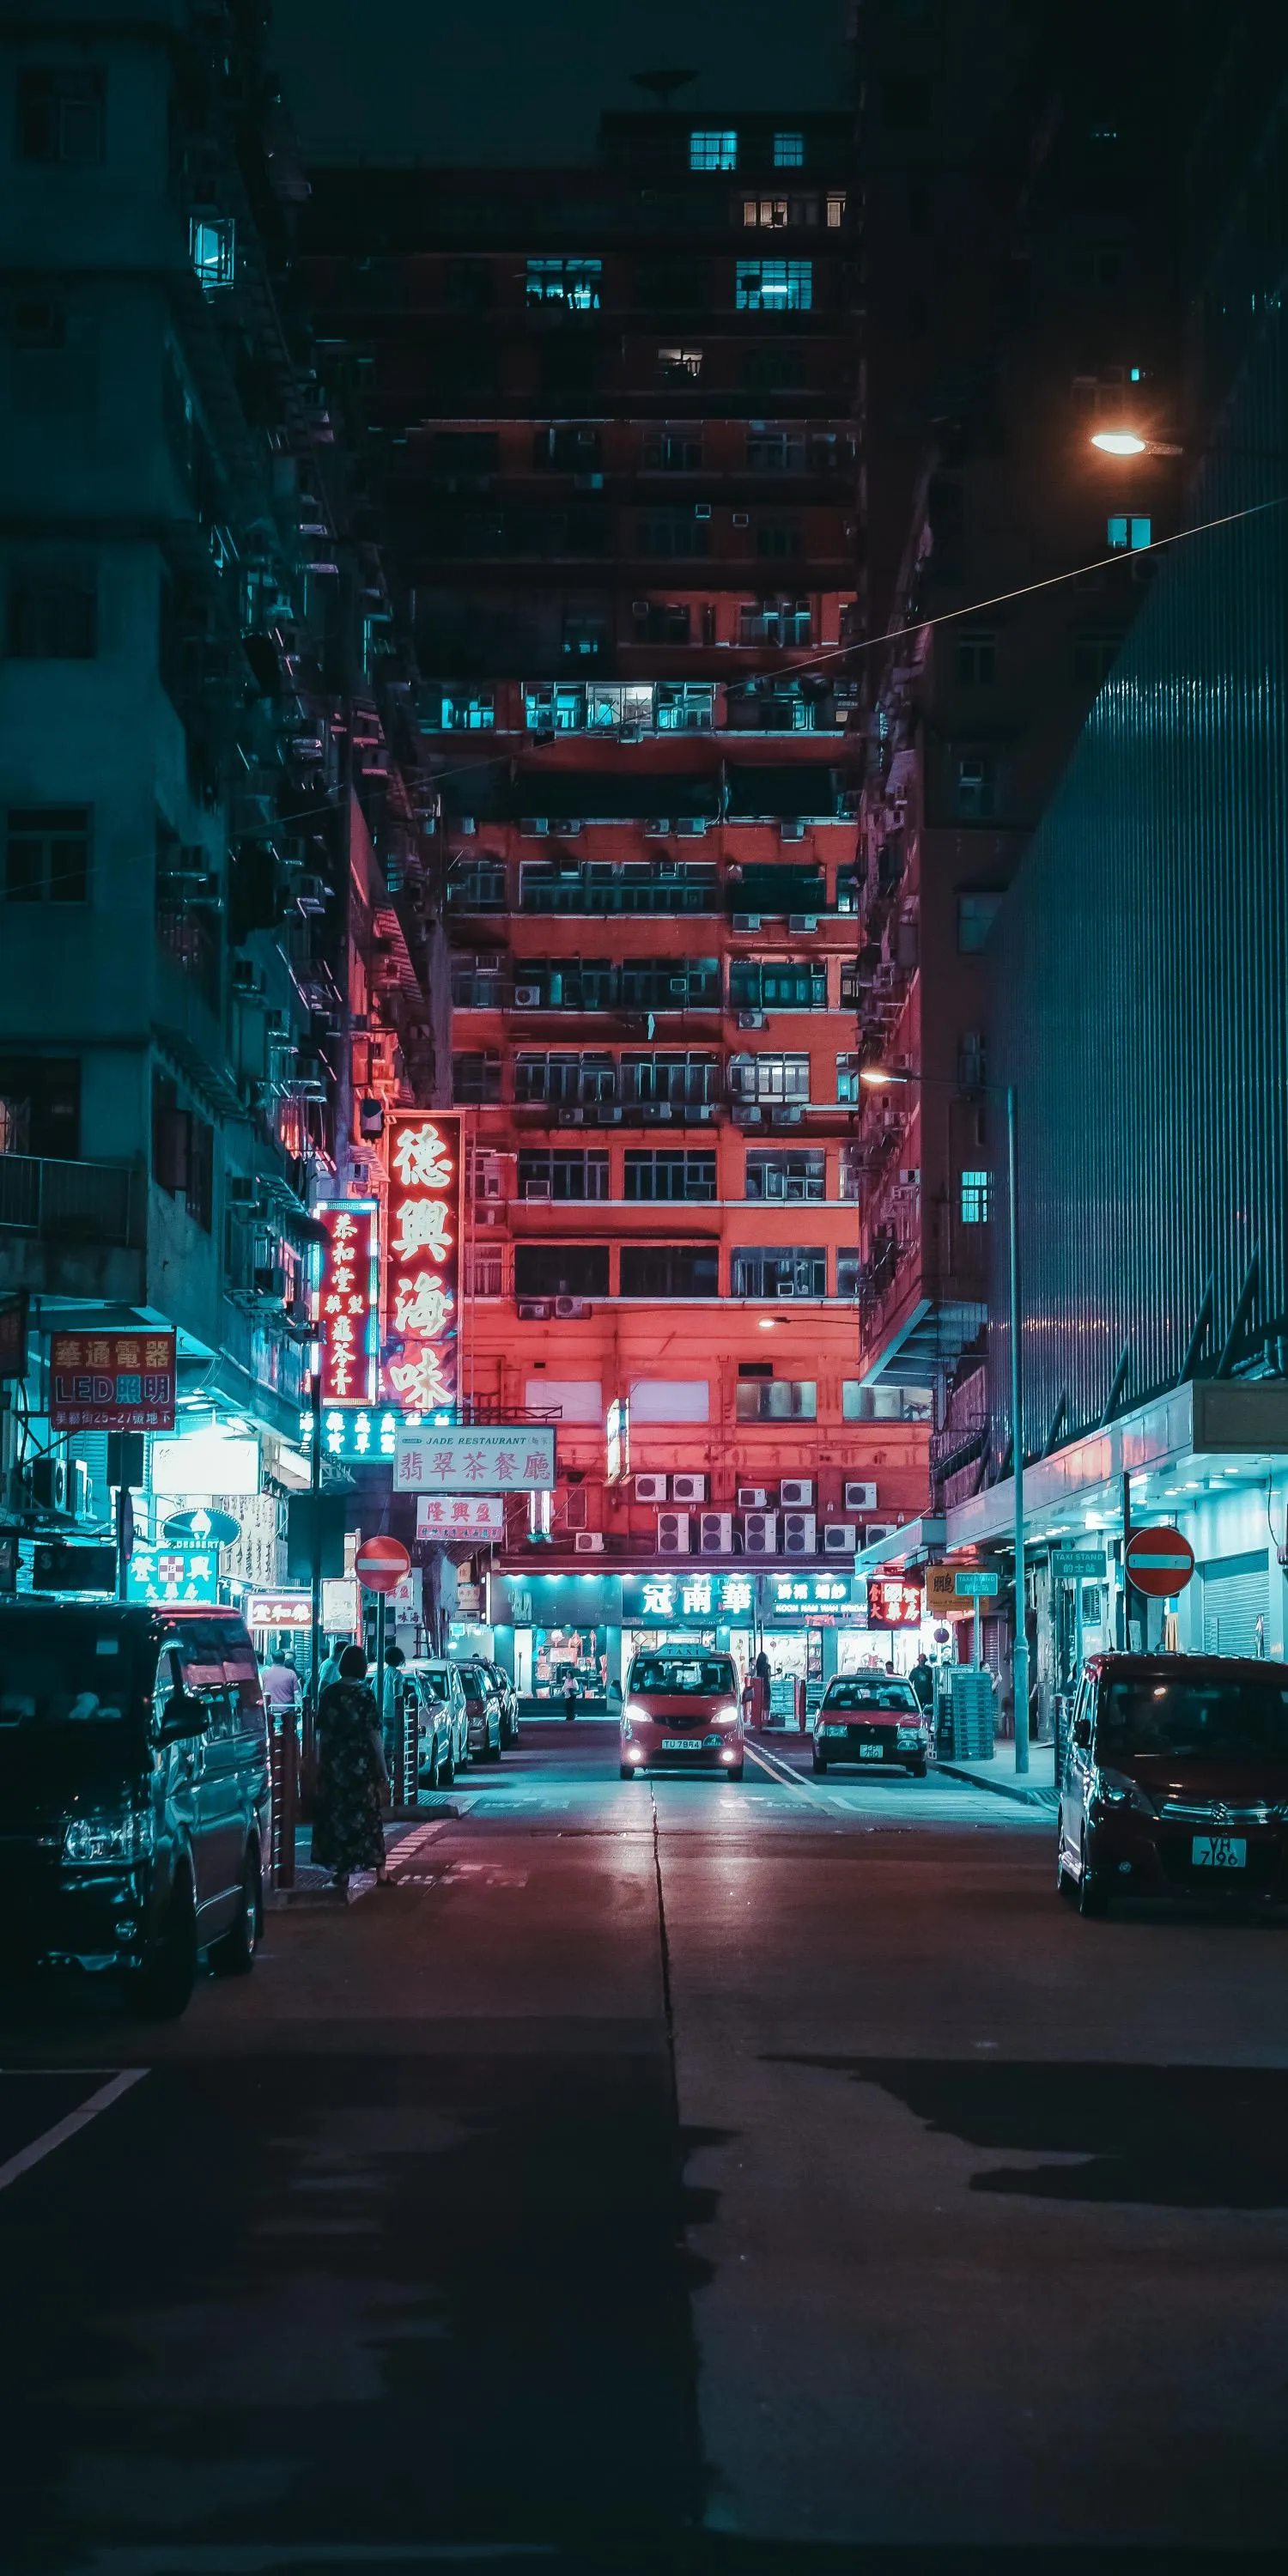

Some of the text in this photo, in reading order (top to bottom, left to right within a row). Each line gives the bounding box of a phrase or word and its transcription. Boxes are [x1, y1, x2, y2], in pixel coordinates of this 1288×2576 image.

[392, 1123, 453, 1413] 德興海味
[55, 1340, 170, 1369] 華通電器
[398, 1451, 551, 1483] 翡翠茶餐廳
[1063, 1563, 1096, 1573] 的士站
[641, 1583, 751, 1614] 冠南華
